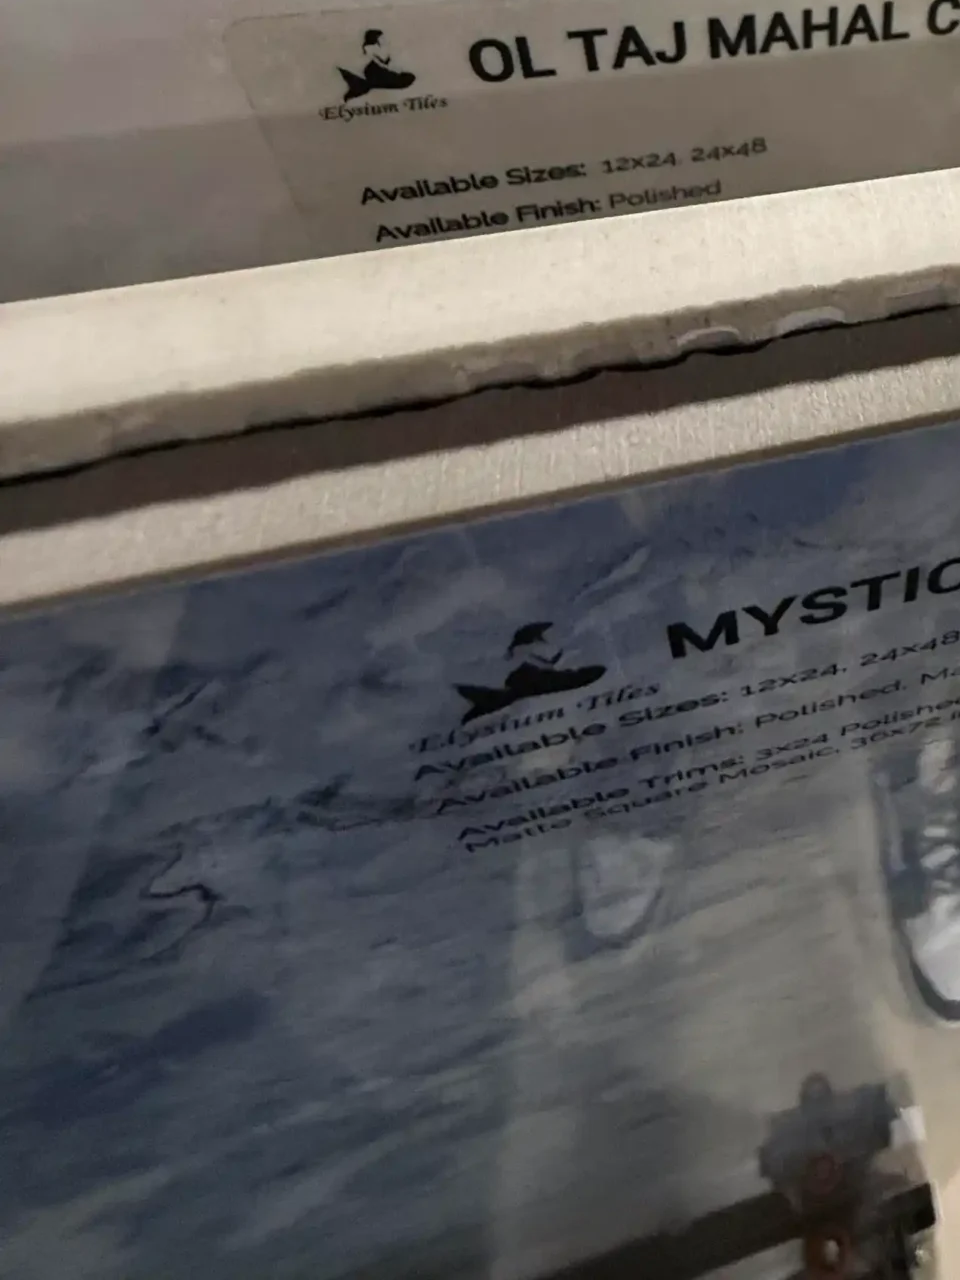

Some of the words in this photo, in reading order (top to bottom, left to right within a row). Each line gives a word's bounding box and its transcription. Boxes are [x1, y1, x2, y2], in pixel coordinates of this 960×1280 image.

[468, 37, 556, 83] OL
[567, 21, 687, 72] TAJ
[707, 1, 910, 59] MAHAL
[361, 174, 499, 205] Available
[505, 162, 587, 186] Sizes:
[691, 137, 767, 163] 24x48
[375, 211, 509, 243] Available
[516, 194, 602, 223] Finish:
[609, 179, 721, 210] Polished
[414, 723, 607, 782] Available
[618, 691, 729, 726] Sizes:
[436, 756, 619, 815] Available
[629, 722, 744, 761] Finish:
[457, 788, 630, 841] Available
[640, 754, 745, 788] Trims:
[464, 819, 572, 853] Matte
[583, 782, 709, 822] Square
